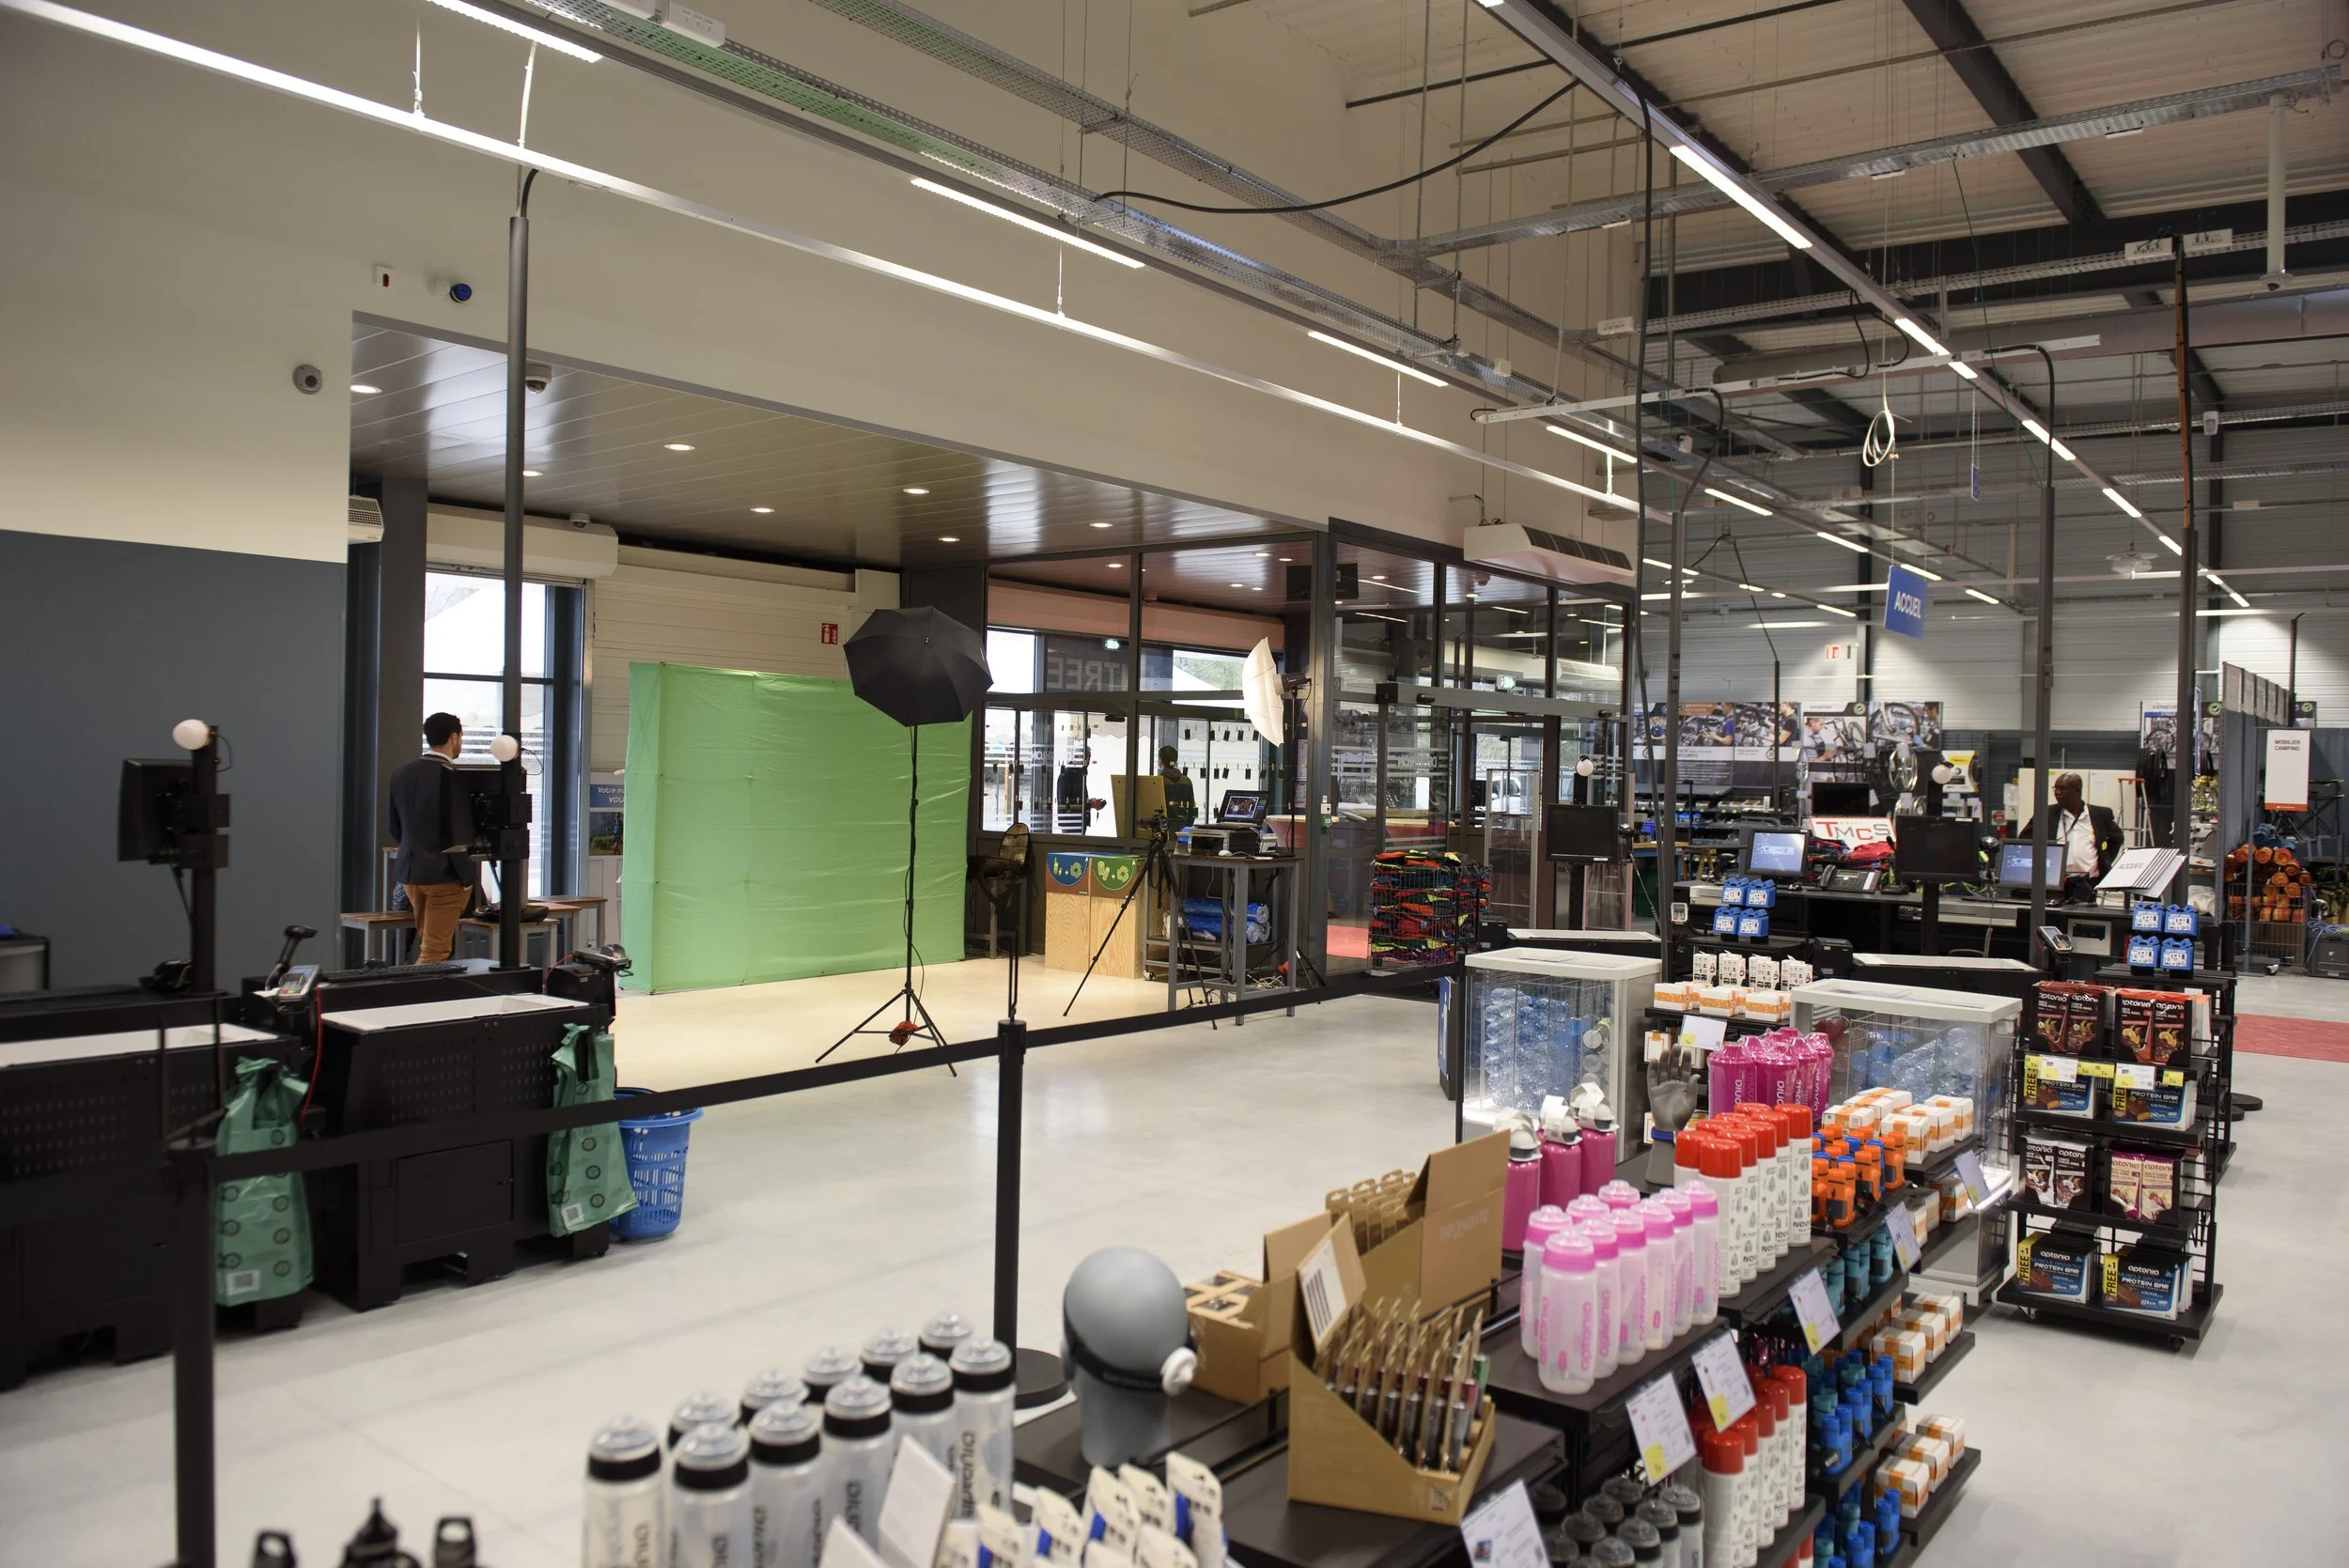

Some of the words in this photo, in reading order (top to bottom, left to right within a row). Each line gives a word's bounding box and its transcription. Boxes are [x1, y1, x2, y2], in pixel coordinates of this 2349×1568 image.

[1894, 591, 1921, 619] ACCUEIL
[1816, 821, 1890, 842] TMCS
[2130, 1090, 2162, 1098] PROTEIN
[2040, 1250, 2070, 1261] aptonia
[2034, 1262, 2064, 1271] PROTEIN
[2128, 1265, 2159, 1276] aptonia
[2122, 1277, 2153, 1287] PROTEIN
[2153, 1281, 2170, 1290] BAR
[1580, 1301, 1593, 1372] aptonia
